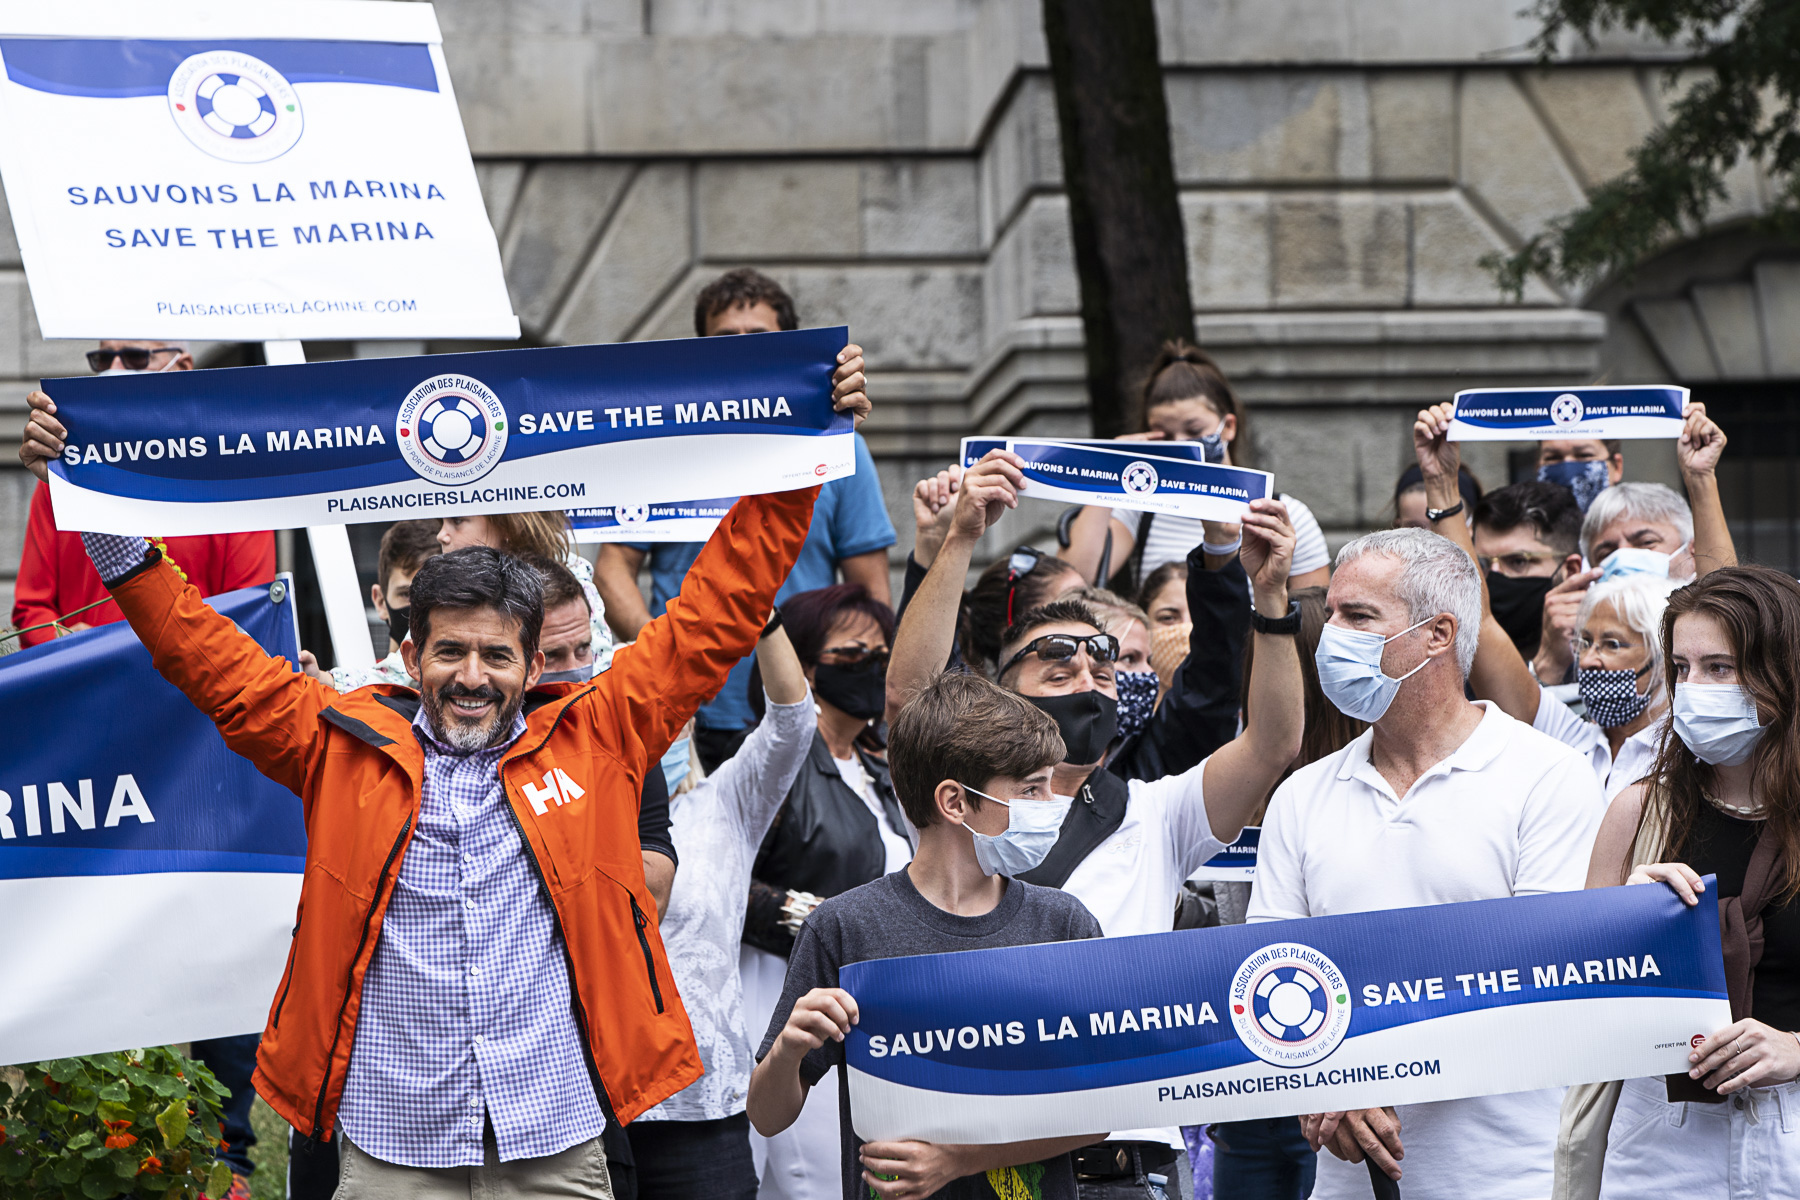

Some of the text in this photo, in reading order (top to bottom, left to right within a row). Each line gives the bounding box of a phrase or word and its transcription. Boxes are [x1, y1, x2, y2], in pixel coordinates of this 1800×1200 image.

[67, 180, 446, 205] SAUVONS LA MARINA
[105, 221, 435, 249] SAVE THE MARINA
[157, 299, 417, 316] PLAISANCIERSLACHINE.COM
[401, 378, 502, 425] ASSOCIATION DES PLAISANCIERS
[519, 396, 793, 435] SAVE THE MARINA
[1458, 407, 1549, 418] SAUVONS LA MARINA
[1585, 405, 1666, 415] SAVE THE MARINA
[64, 424, 386, 466] SAUVONS LA MARINA
[403, 435, 502, 479] DU PORT DE PLAISANCE DE LACHINE
[1023, 461, 1064, 474] AUVONS
[1065, 466, 1079, 476] LA
[1080, 468, 1119, 482] MARINA
[327, 483, 586, 513] PLAISANCIERSLACHINE.COM
[1160, 478, 1249, 498] SAVE THE MARINA
[576, 508, 613, 517] MARINA
[651, 508, 729, 517] SAVE THE MARIN
[1229, 846, 1257, 854] MARIN
[1234, 947, 1343, 1000] ASSOCIATION DES PLAISANCIERS
[1362, 954, 1662, 1007] SAVE THE MARINA
[868, 1001, 1219, 1058] SAUVONS LA MARINA
[1238, 1008, 1345, 1060] DU PORT DE PLAISANCE DE LACHINE
[1654, 1042, 1675, 1050] OFFERT
[1157, 1059, 1441, 1102] PLAISANCIERSLACHINE.COM
